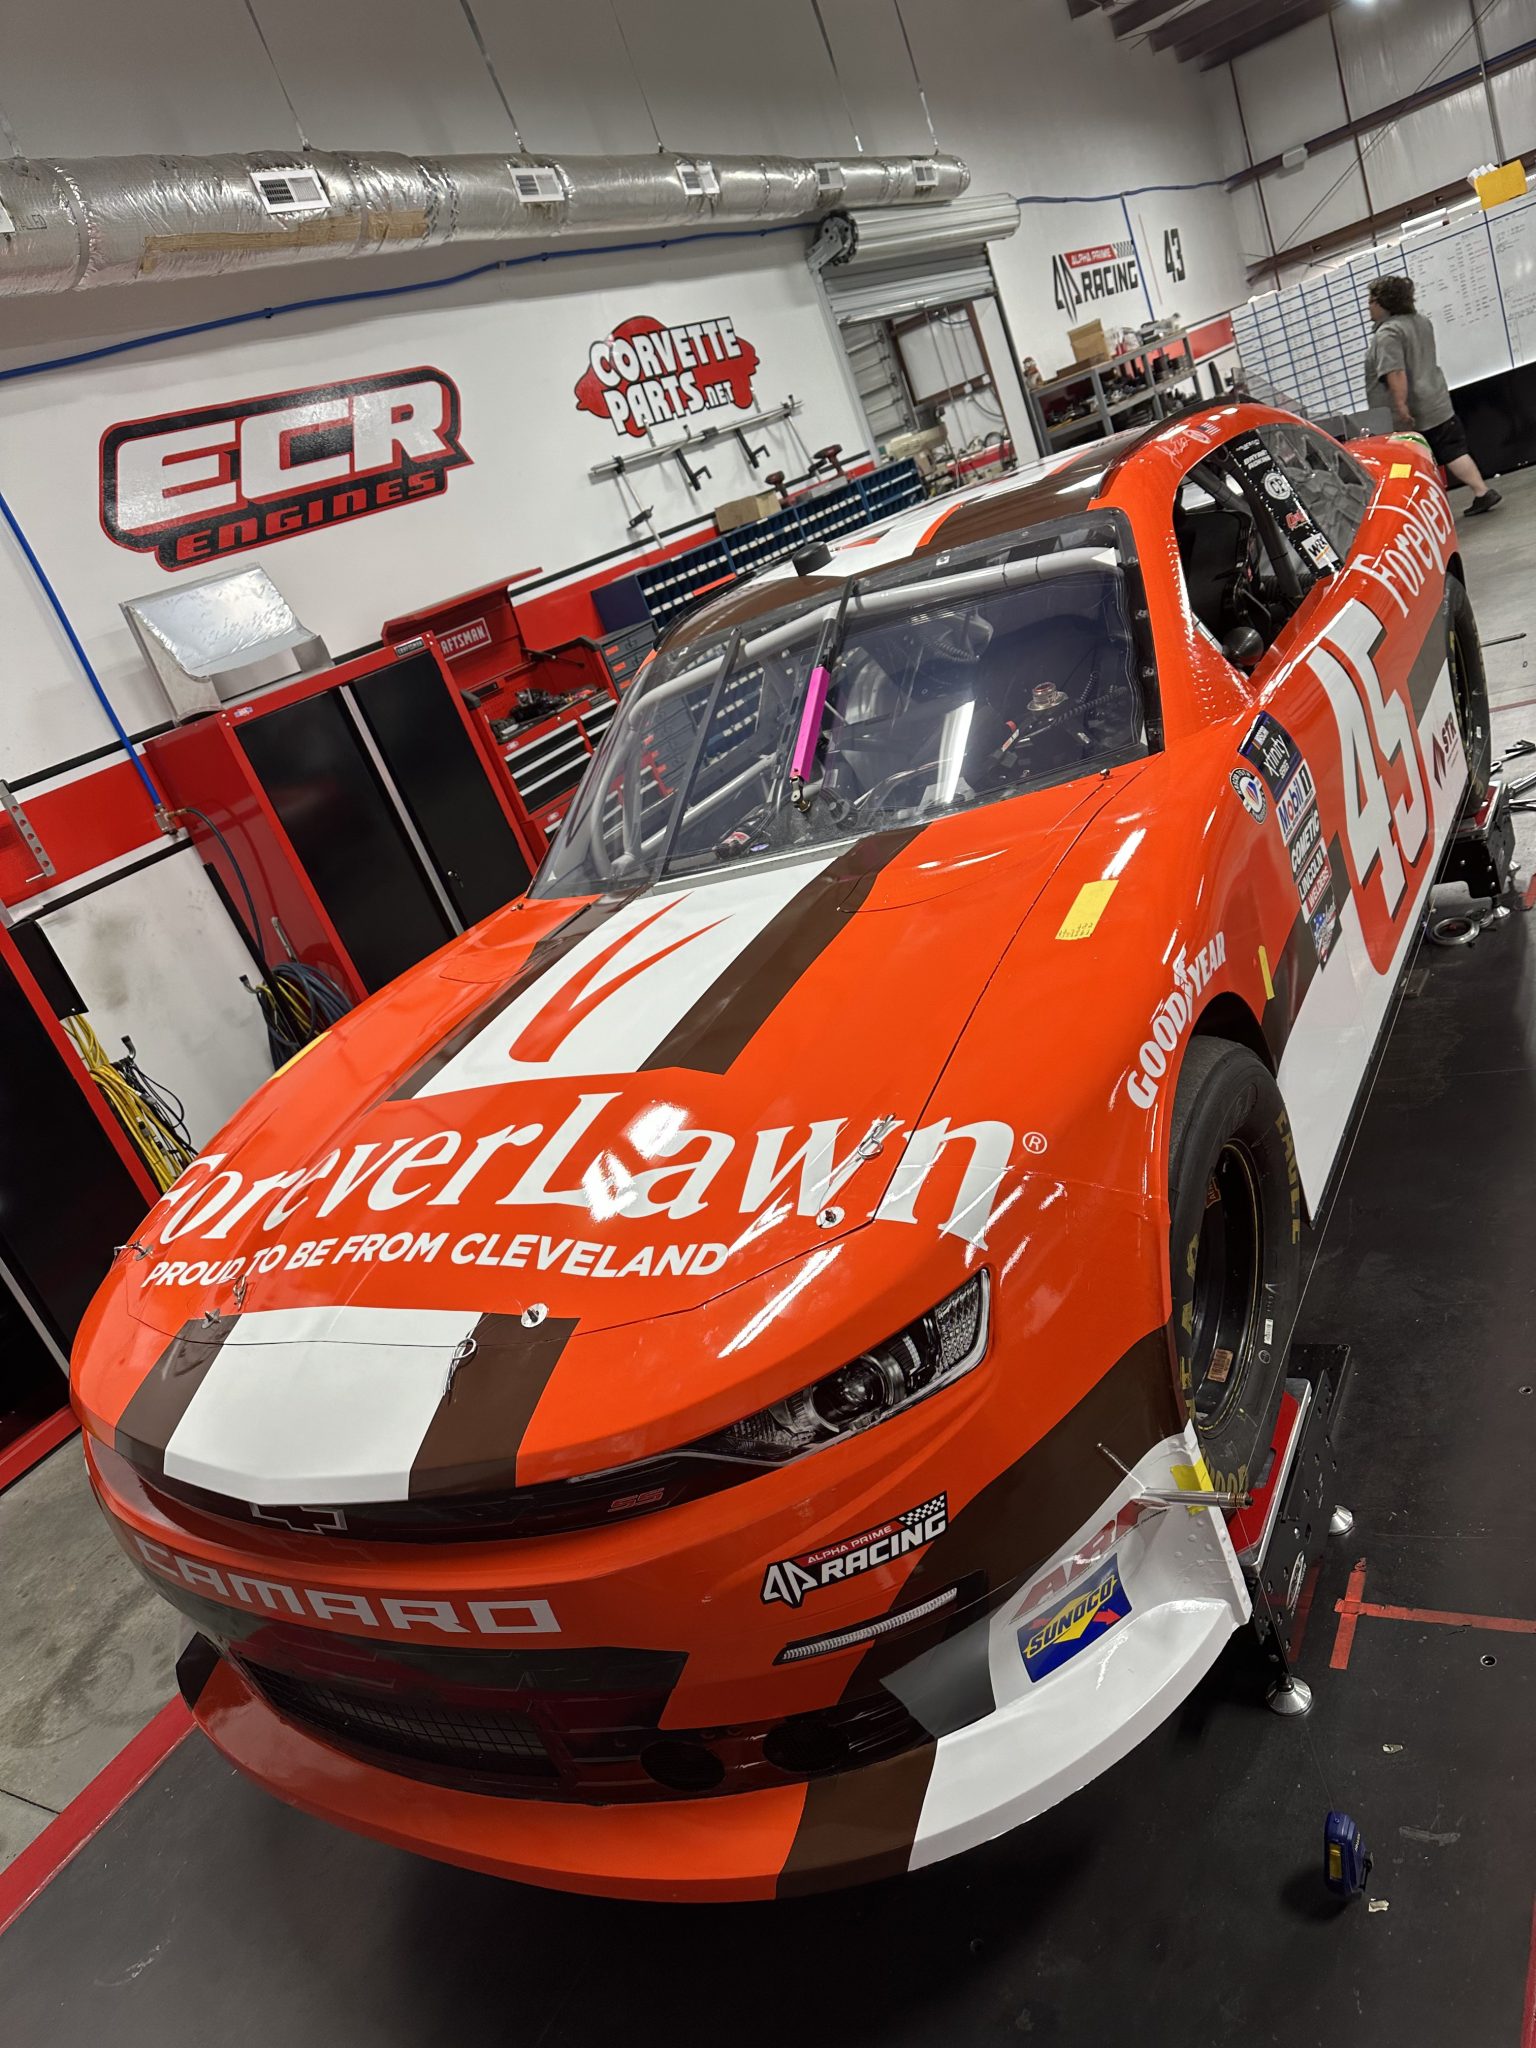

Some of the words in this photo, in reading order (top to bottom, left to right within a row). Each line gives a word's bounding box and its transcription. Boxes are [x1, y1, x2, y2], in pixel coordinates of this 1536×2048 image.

[1081, 260, 1139, 302] RACING
[1164, 228, 1186, 283] 43
[591, 318, 743, 388] CORVETTE
[116, 379, 452, 533] ECR
[176, 469, 438, 561] ENGINES
[440, 625, 486, 655] AFTSMAN
[1263, 734, 1291, 777] xfinity
[1306, 598, 1430, 920] 45
[1278, 774, 1305, 834] Mobil
[1301, 764, 1313, 796] 1
[1291, 809, 1320, 873] COMETIC
[1298, 845, 1325, 901] LINCOLN
[1127, 931, 1227, 1110] GOODYEAR
[141, 1260, 246, 1288] PROUD
[246, 1244, 287, 1277] TO
[284, 1237, 339, 1271] BE
[331, 1232, 450, 1266] FROM
[450, 1232, 729, 1278] CLEVELAND
[808, 1543, 850, 1564] ALPHA
[850, 1524, 893, 1548] PRIME
[821, 1509, 947, 1585] RACING
[134, 1535, 563, 1634] CAMARO
[1029, 1576, 1114, 1656] SUNOCO
